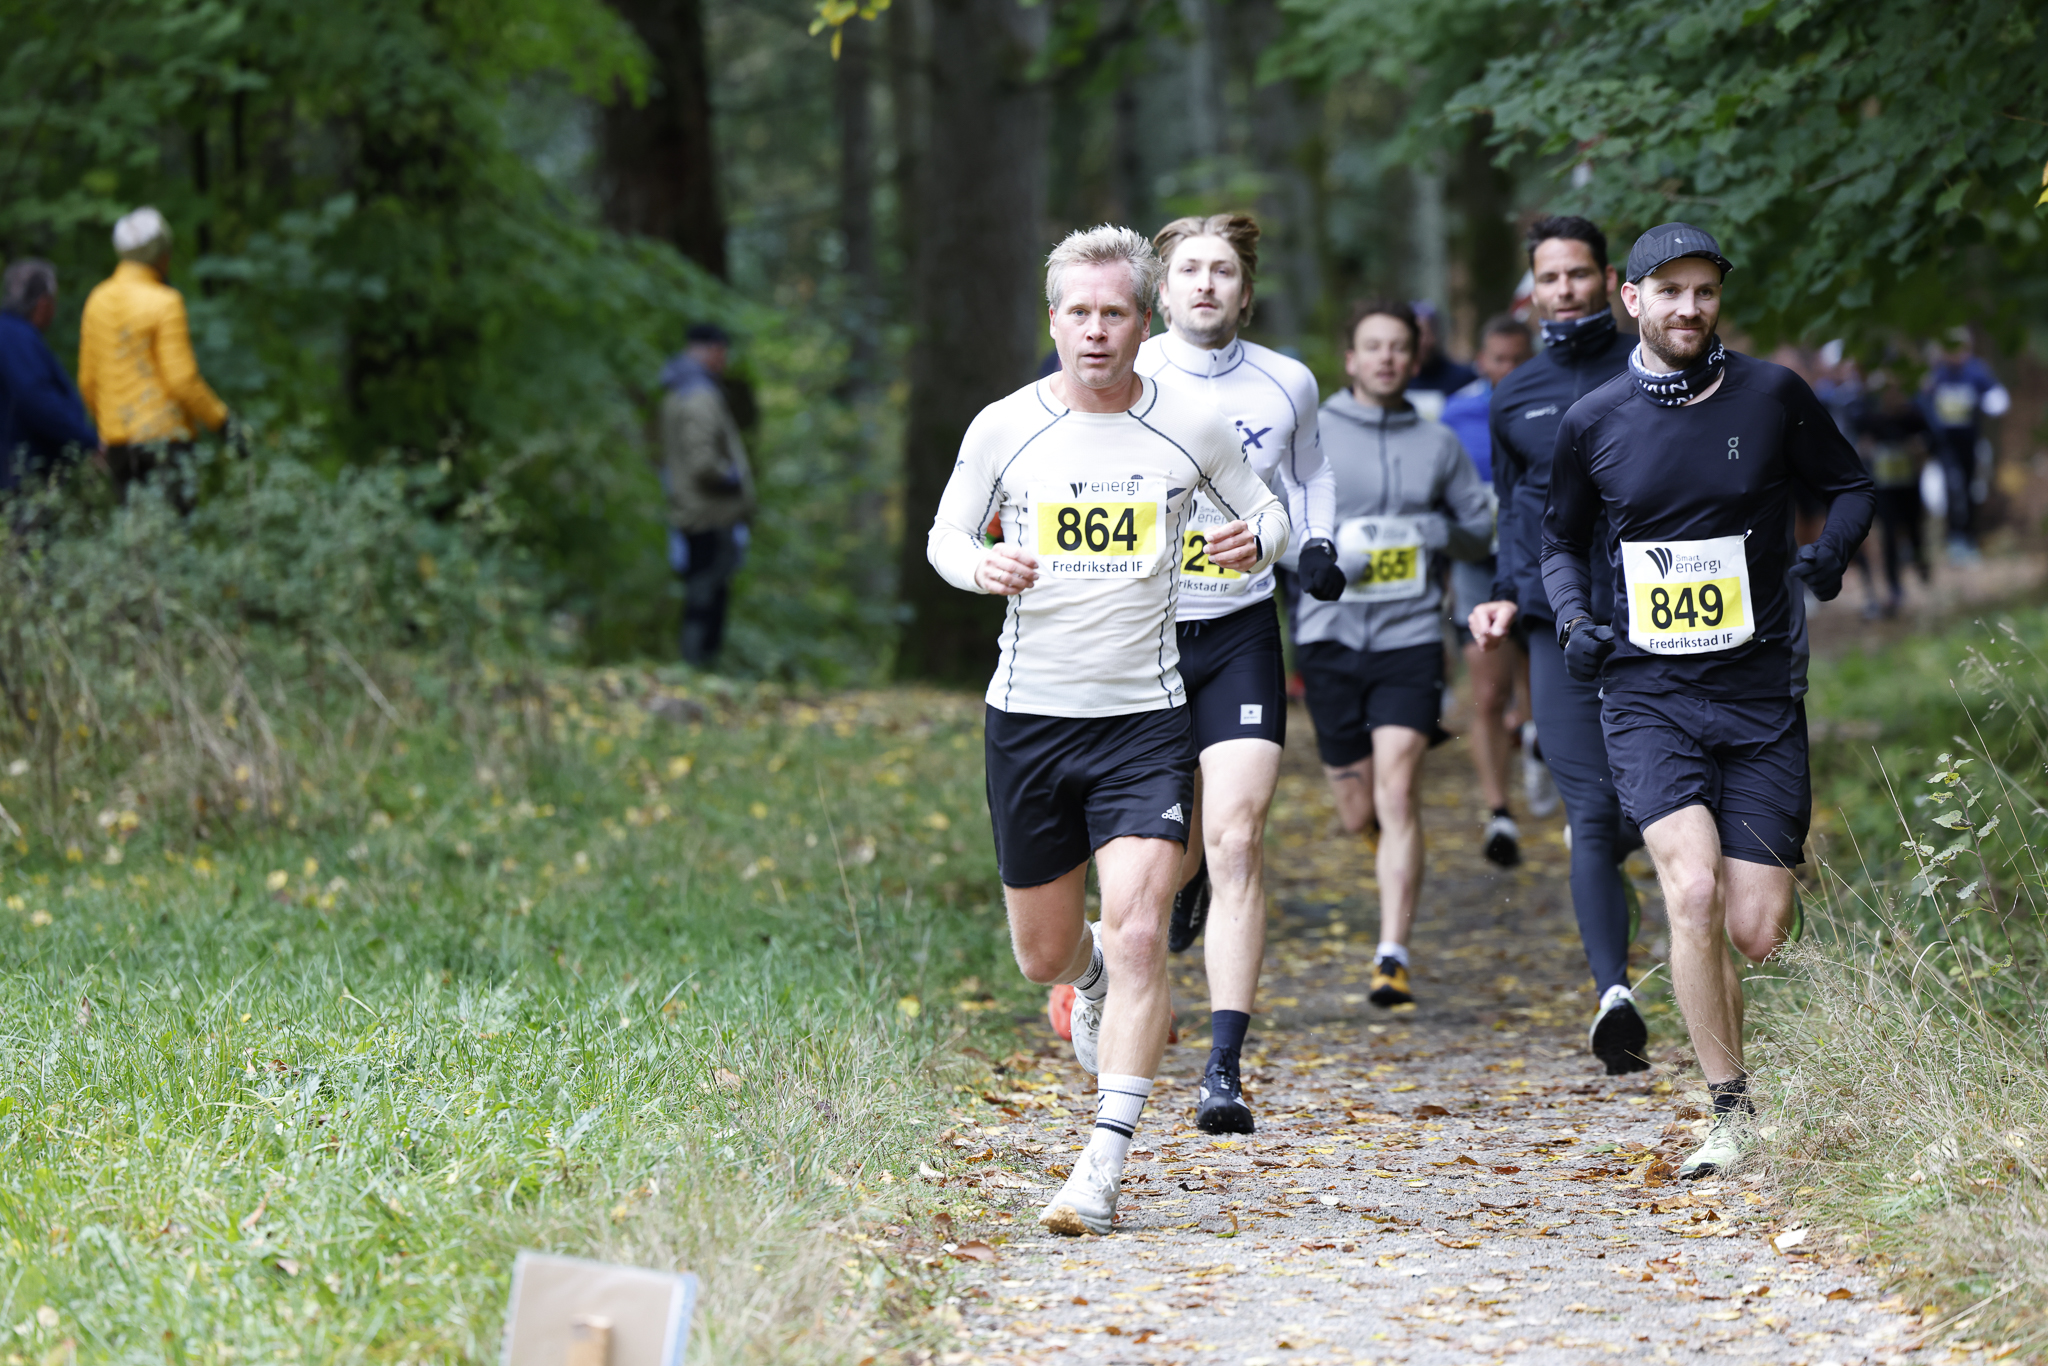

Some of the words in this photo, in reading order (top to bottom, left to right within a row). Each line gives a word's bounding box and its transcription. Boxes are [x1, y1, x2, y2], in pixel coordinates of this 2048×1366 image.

[1200, 505, 1220, 514] Smar
[1197, 512, 1228, 525] ener
[1056, 507, 1137, 552] 864
[1675, 554, 1700, 562] Smart
[1052, 561, 1128, 573] Fredrikstad
[1132, 561, 1143, 572] IF
[1675, 560, 1721, 574] energi
[1178, 580, 1218, 592] rikstad
[1220, 583, 1230, 592] IF
[1651, 584, 1724, 629] 849
[1649, 635, 1719, 649] Fredrikstad
[1722, 633, 1733, 644] IF
